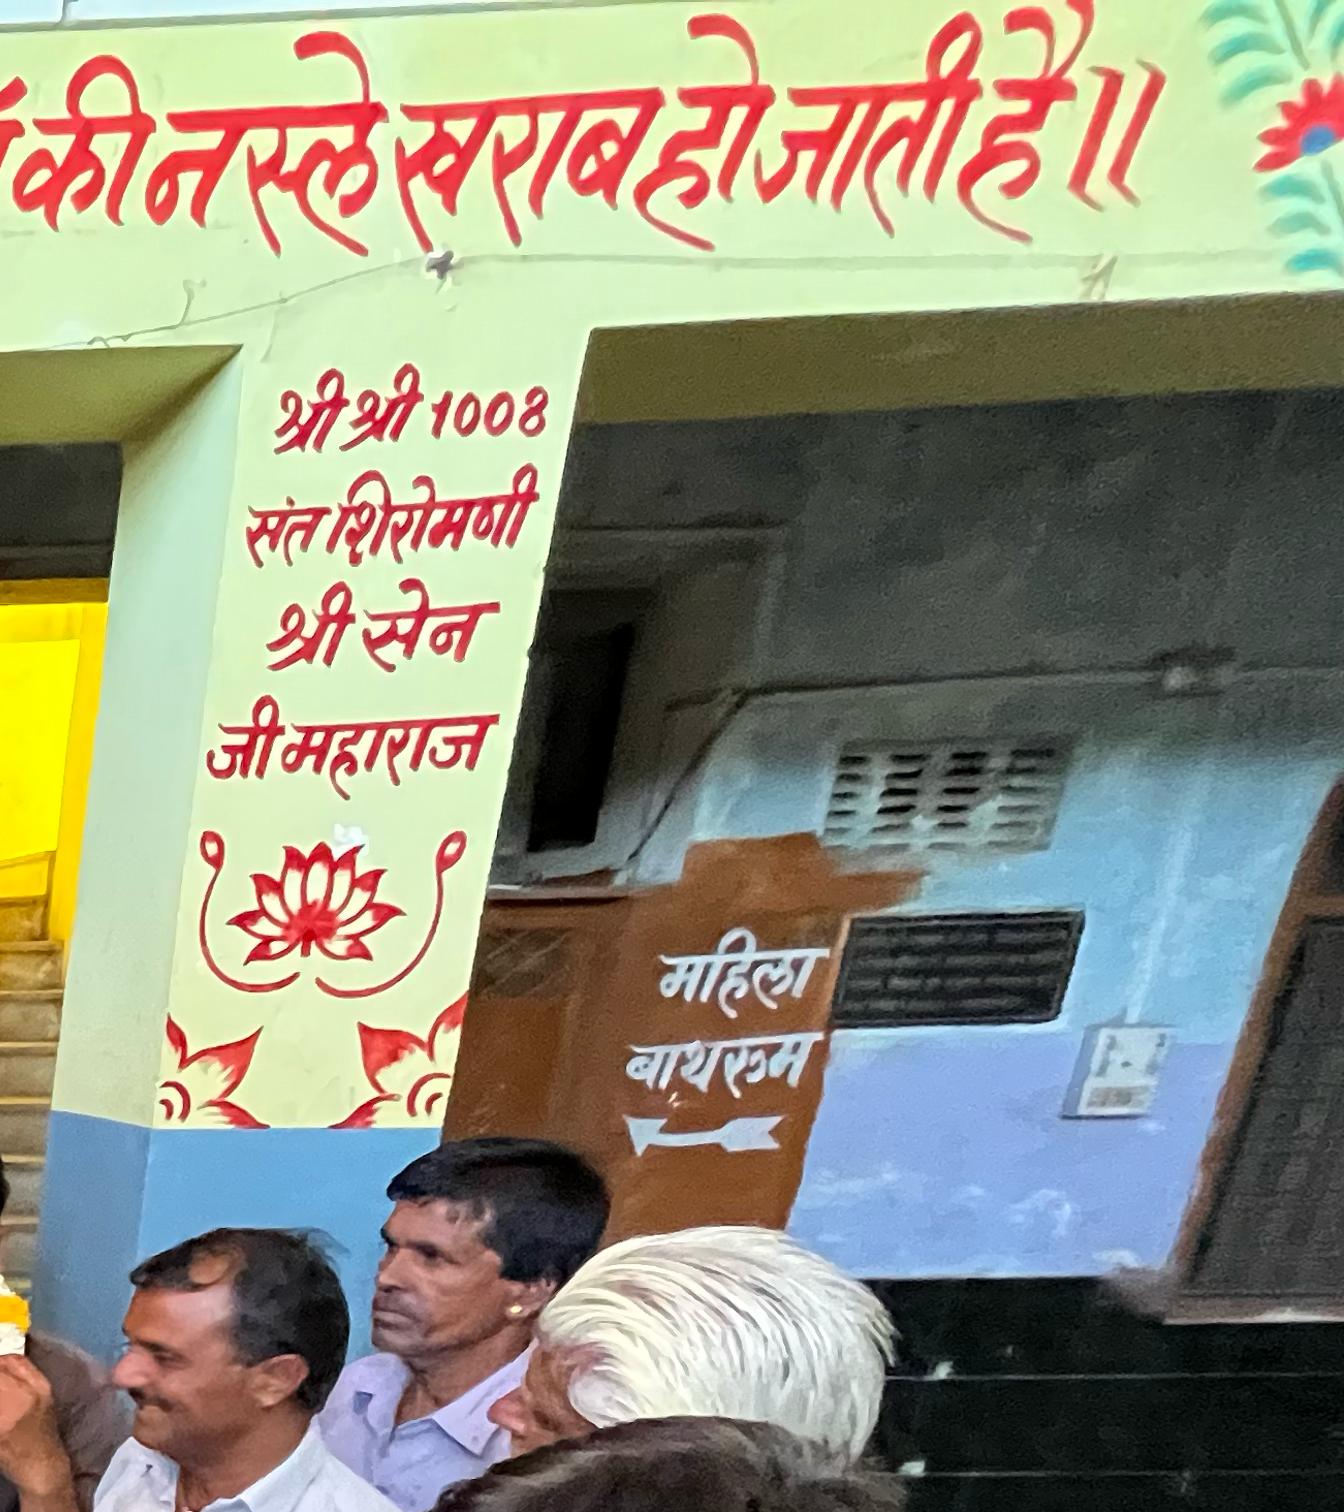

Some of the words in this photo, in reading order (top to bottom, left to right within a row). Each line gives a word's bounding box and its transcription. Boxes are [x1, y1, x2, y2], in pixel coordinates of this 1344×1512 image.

[12, 54, 157, 230] की
[146, 31, 389, 257] नस्ले
[394, 87, 667, 253] खराब
[633, 14, 776, 251] हो
[755, 12, 983, 239] जाती
[273, 367, 350, 456] श्री
[338, 362, 425, 453] श्री
[430, 385, 550, 438] 1008
[245, 496, 333, 568] संत
[265, 580, 357, 673] श्री
[361, 577, 502, 674] सेन
[205, 694, 286, 781] जी
[280, 713, 501, 802] महाराज
[658, 926, 832, 1020] महिला
